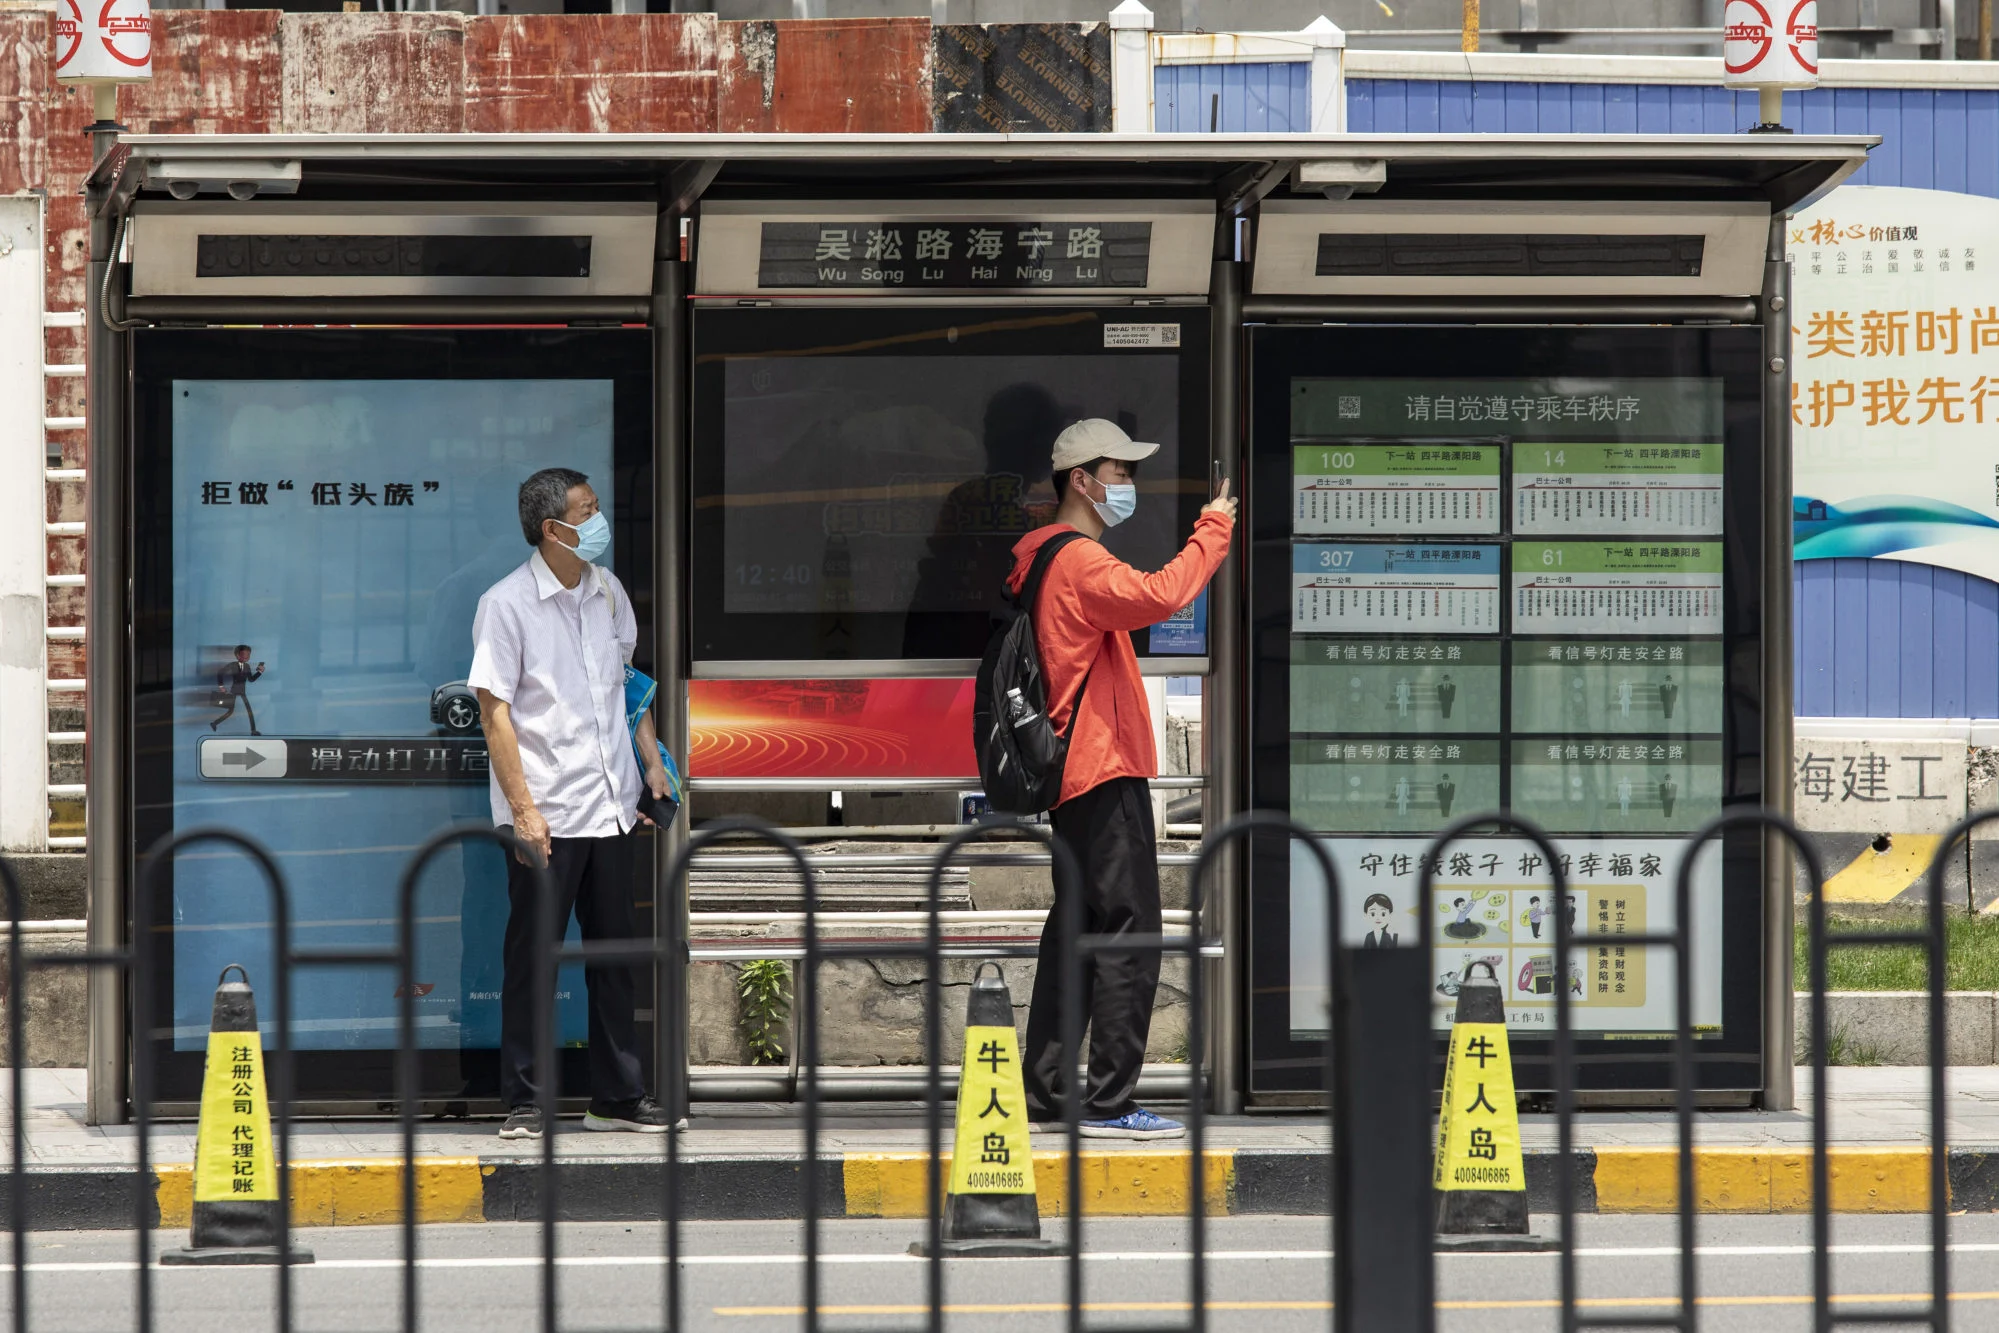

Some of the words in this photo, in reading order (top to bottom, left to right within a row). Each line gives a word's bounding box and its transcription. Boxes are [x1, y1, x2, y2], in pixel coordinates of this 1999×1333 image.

[1017, 46, 1094, 113] ZIQINMUYE
[1786, 219, 1918, 245] 义核心价值观
[815, 227, 1104, 262] 吴淞路海宁路
[818, 267, 848, 281] Wu
[860, 268, 904, 283] Song
[922, 267, 944, 280] Lu
[971, 266, 998, 280] Hai
[1016, 266, 1053, 282] Ning
[1076, 265, 1098, 279] Lu
[1792, 306, 1999, 359] 类新时尚
[1405, 395, 1640, 421] 请自觉遵守乘车秩序
[1322, 453, 1355, 469] 100
[1385, 451, 1416, 462] 下一站
[1543, 450, 1566, 467] 14
[1604, 448, 1634, 459] 下一站
[1316, 478, 1353, 487] 巴士一公司
[1535, 477, 1573, 486] 巴士一公司
[1319, 551, 1354, 567] 307
[1385, 549, 1415, 560] 下一站
[1542, 549, 1563, 566] 61
[1604, 547, 1634, 558] 下一站
[736, 564, 811, 586] 12:40
[1316, 577, 1352, 585] 巴士一公司
[1535, 576, 1573, 585] 巴士一公司
[1326, 645, 1462, 661] 看信号灯走安全路
[1548, 645, 1684, 661] 看信号灯走安全路
[1326, 744, 1462, 760] 看信号灯走安全路
[1547, 744, 1684, 760] 看信号灯走安全路
[1598, 899, 1608, 993] 警惕非集资陷阱
[1615, 899, 1625, 993] 树立正理财观念
[231, 1046, 253, 1115] 注册公司
[977, 1039, 1010, 1166] 牛人岛
[1465, 1035, 1497, 1161] 牛人岛
[232, 1124, 254, 1194] 代理记账
[967, 1171, 1024, 1188] 4008406865
[1454, 1167, 1510, 1183] 4008406865
